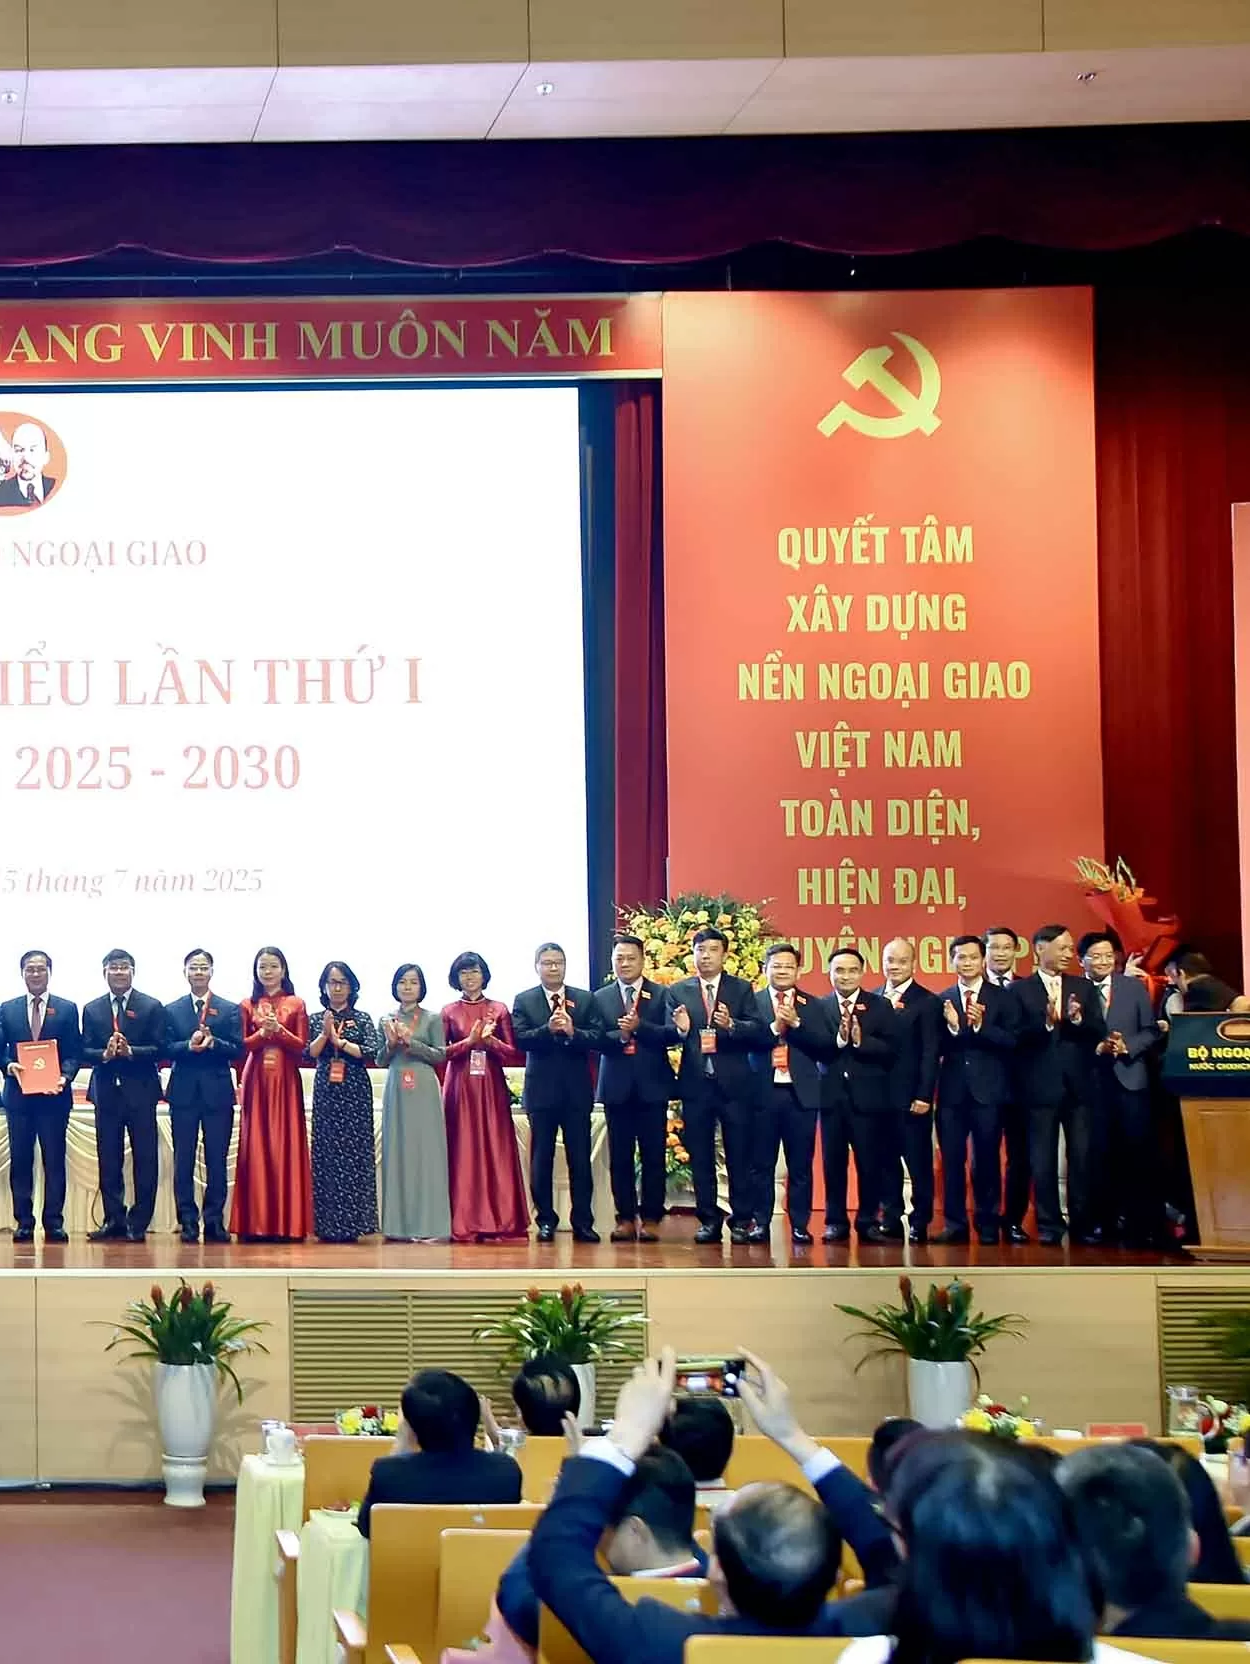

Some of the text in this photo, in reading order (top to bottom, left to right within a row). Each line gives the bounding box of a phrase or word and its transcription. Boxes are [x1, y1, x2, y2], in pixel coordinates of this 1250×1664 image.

[140, 321, 280, 364] VINH
[296, 308, 467, 362] MUÔN
[485, 306, 616, 359] NĂM
[11, 538, 116, 573] NGOẠI
[125, 539, 208, 567] GIAO
[777, 513, 974, 570] QUYẾT TÂM
[786, 583, 967, 640] XÂY DỰNG
[113, 641, 234, 706] LẦN
[252, 645, 388, 706] THỨ
[404, 656, 424, 704] I
[737, 649, 1031, 709] NỀN NGOẠI GIAO
[14, 743, 132, 792] 2025
[182, 743, 302, 791] 2030
[795, 720, 962, 777] VIỆT NAM
[779, 788, 980, 845] TOÀN DIỆN,
[201, 868, 265, 894] 2025
[798, 857, 967, 913] HIỆN ĐẠI,
[1187, 1045, 1209, 1061] BỘ
